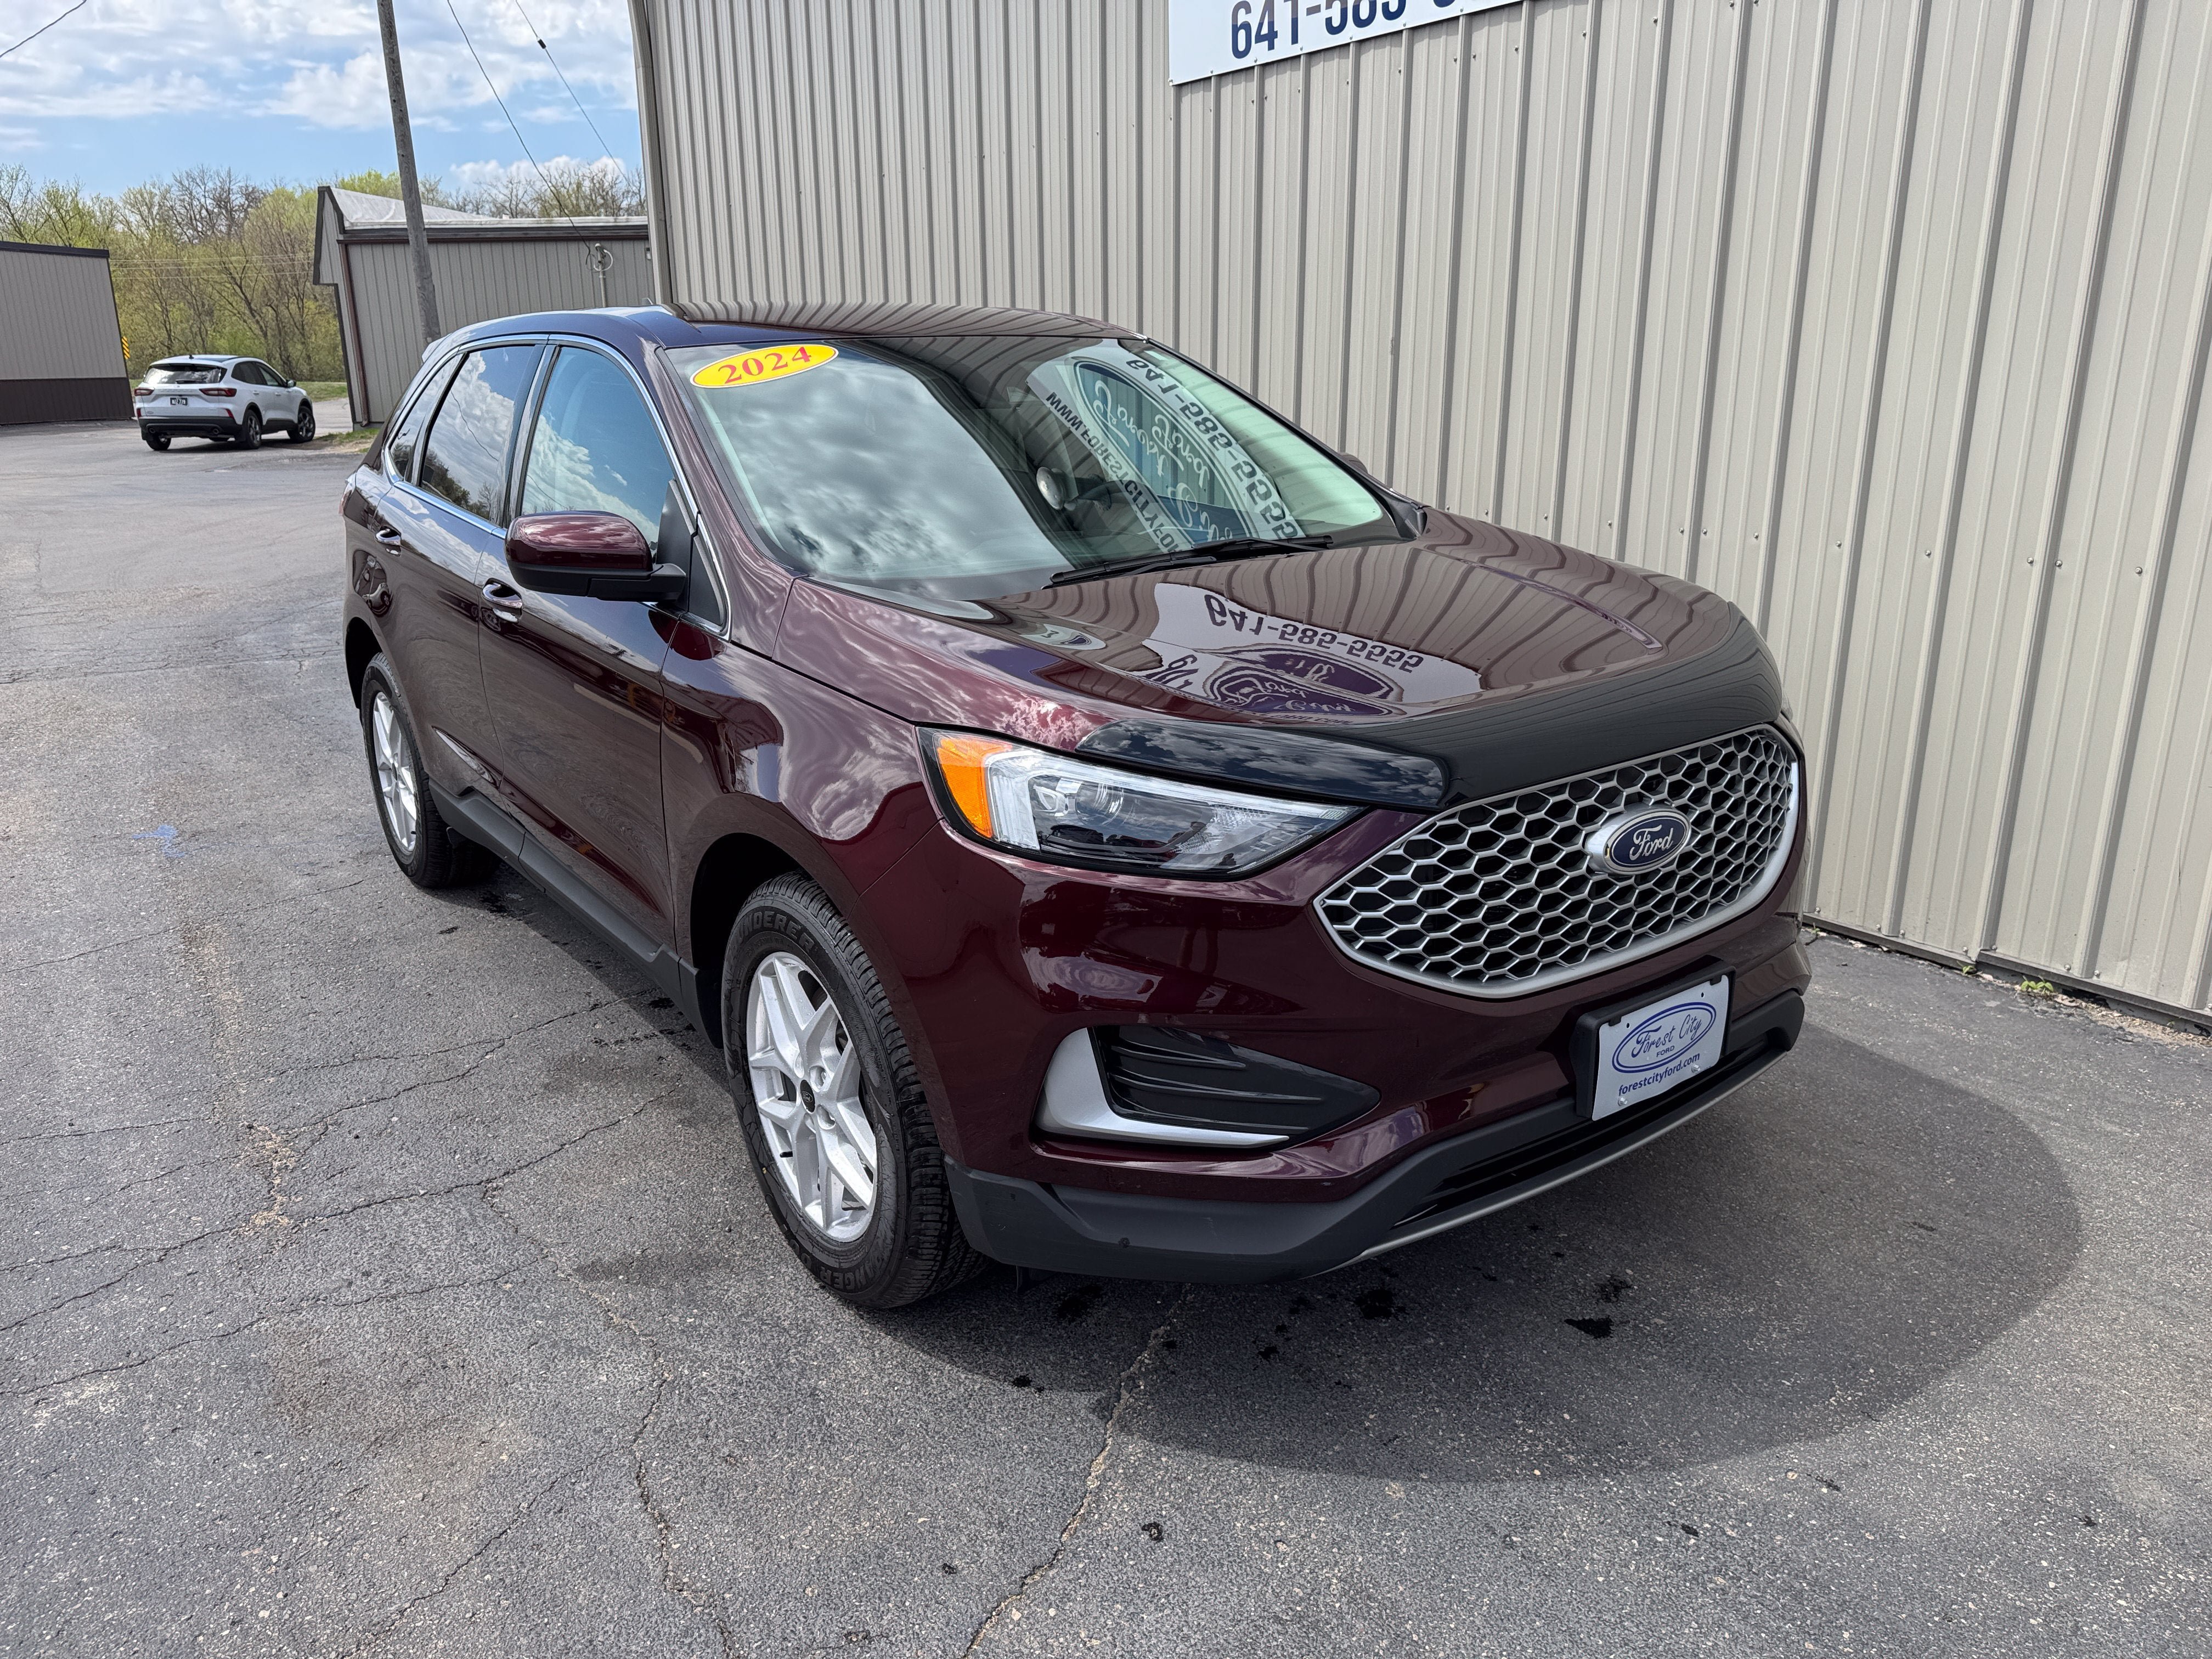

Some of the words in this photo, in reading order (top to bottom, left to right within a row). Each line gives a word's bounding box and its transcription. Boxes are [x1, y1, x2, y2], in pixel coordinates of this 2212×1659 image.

[718, 346, 812, 383] 2024
[1629, 824, 1674, 861] Ford
[1631, 1025, 1675, 1058] Forest
[1679, 1014, 1702, 1041] City
[1656, 1045, 1675, 1058] FORD
[1618, 1053, 1700, 1096] forestcityford.com
